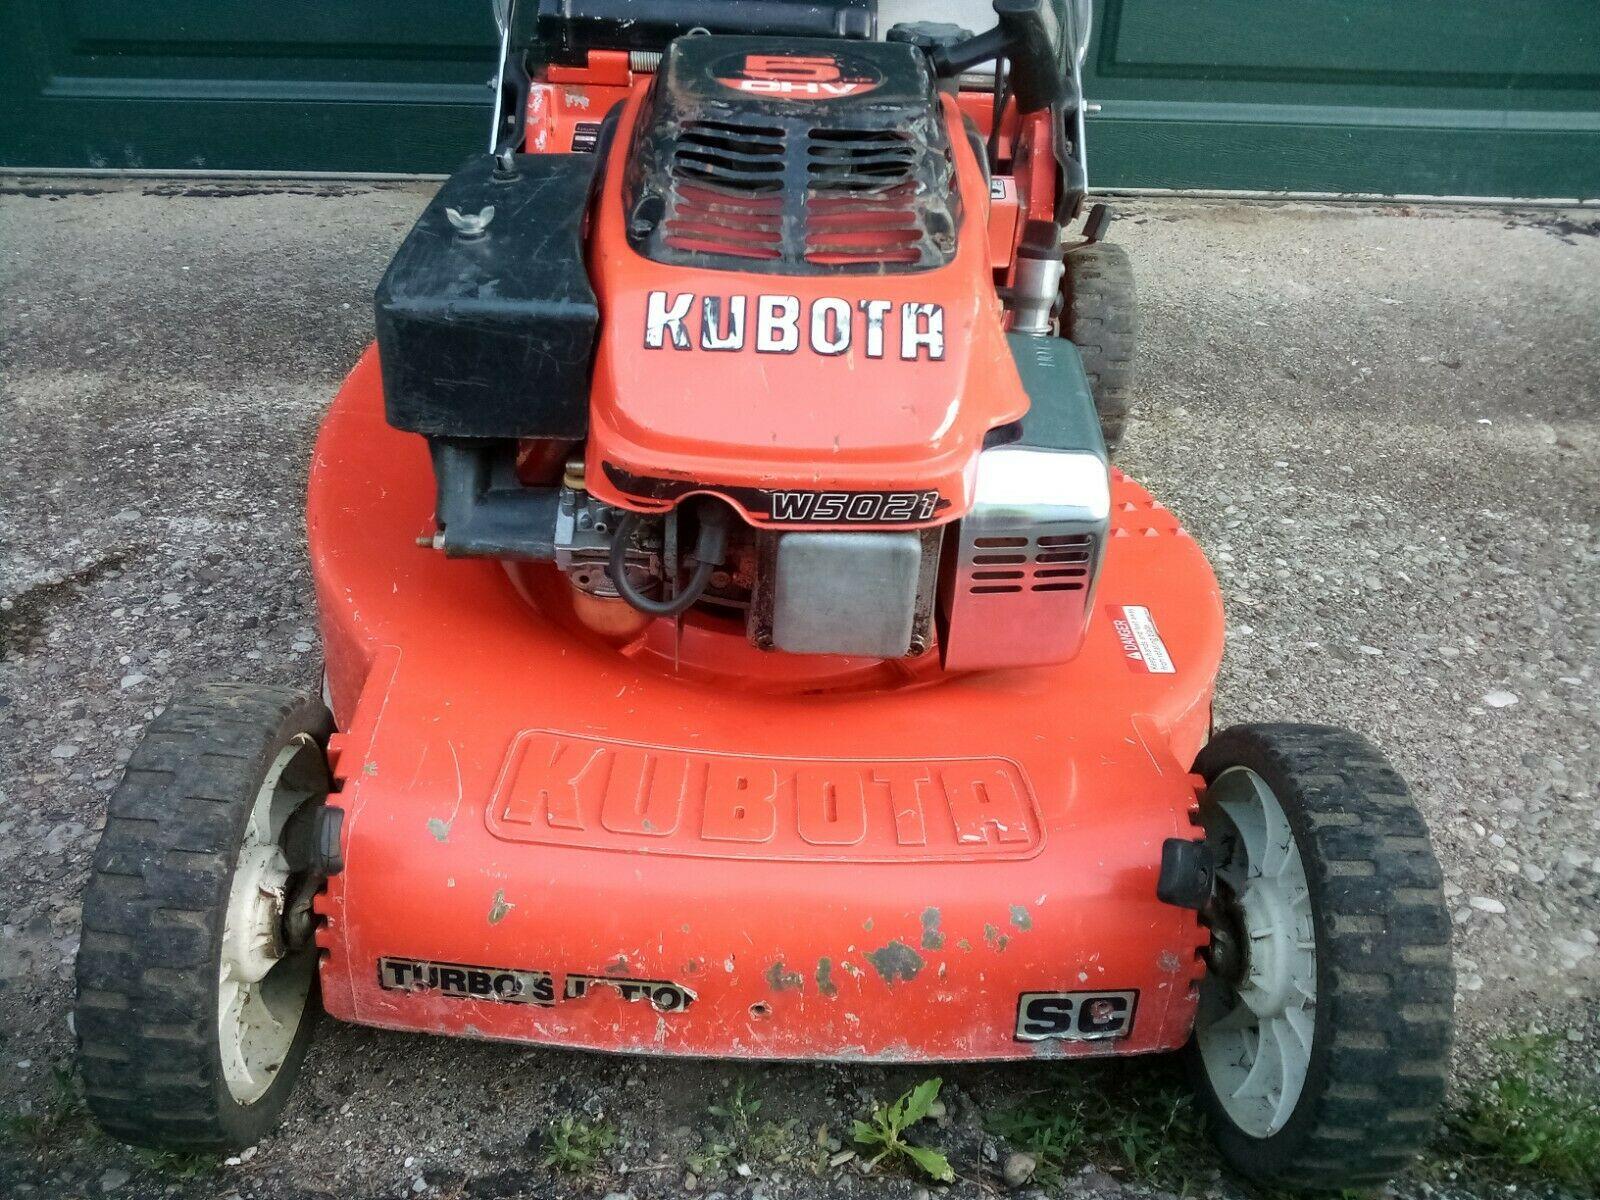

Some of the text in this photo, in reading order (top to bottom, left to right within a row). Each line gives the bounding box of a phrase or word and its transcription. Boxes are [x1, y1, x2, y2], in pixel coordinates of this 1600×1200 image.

[742, 55, 841, 81] 5
[643, 290, 945, 361] KUBOTA
[773, 491, 939, 520] W5021
[1113, 619, 1139, 651] DANGER
[501, 738, 1031, 847] KUBOTA
[385, 961, 523, 999] TURBO
